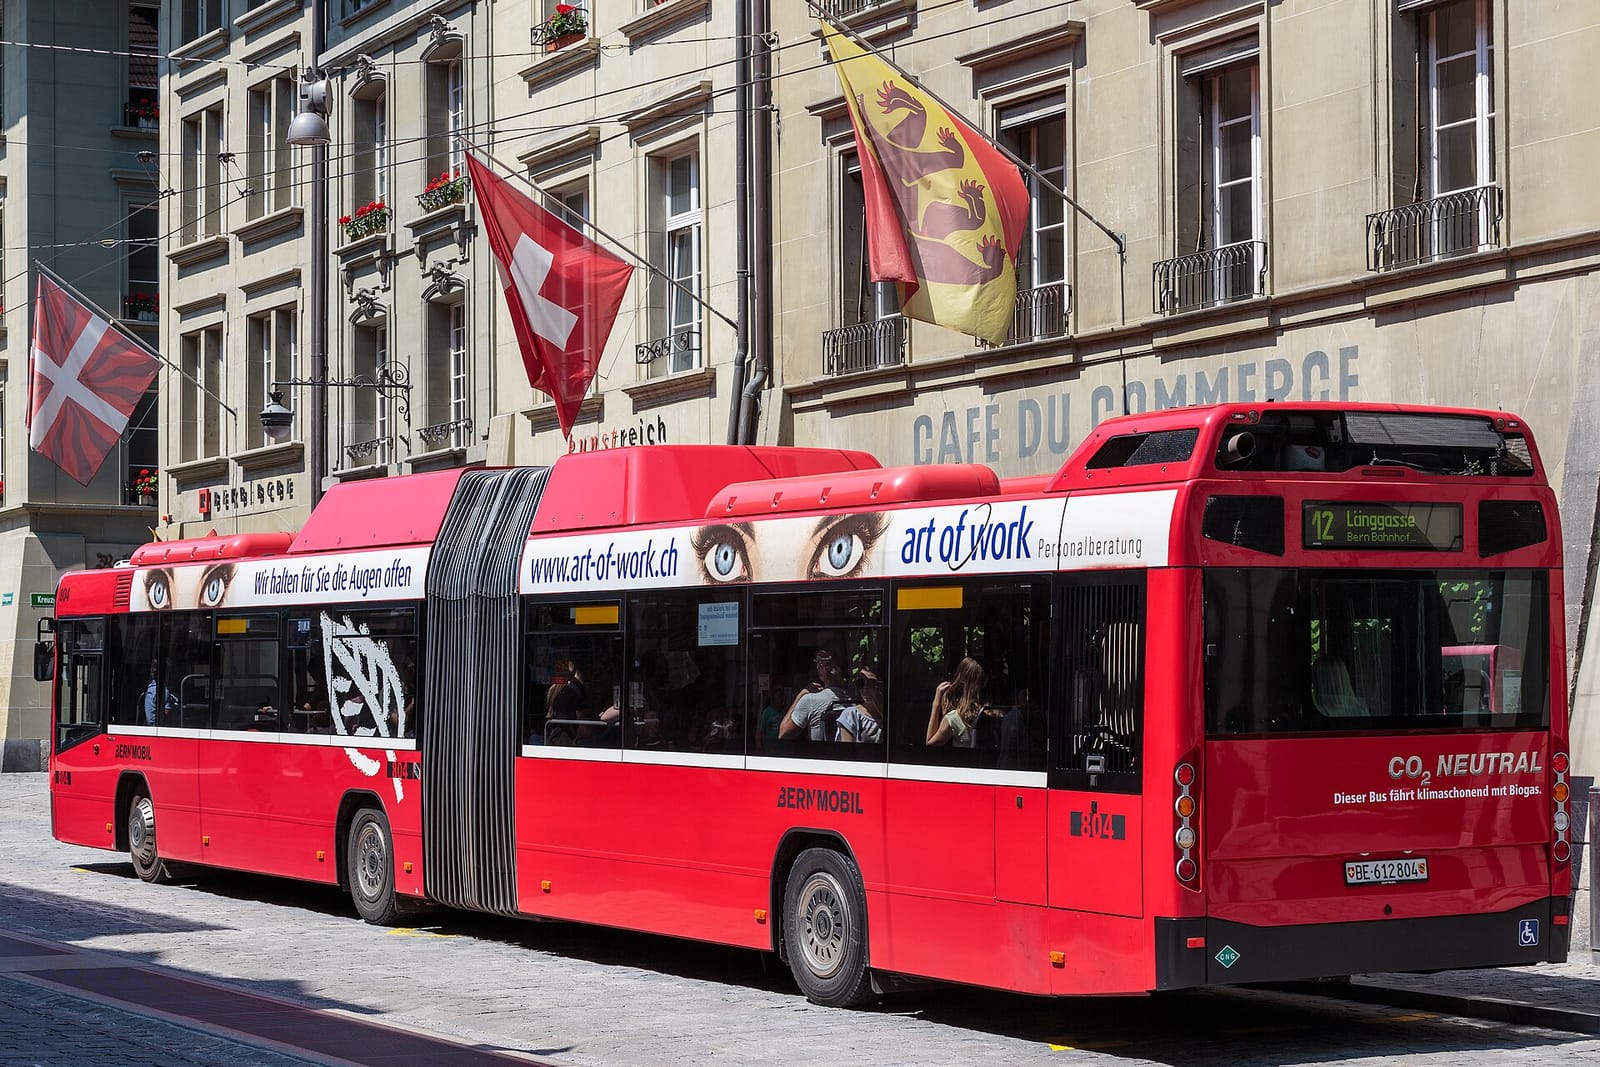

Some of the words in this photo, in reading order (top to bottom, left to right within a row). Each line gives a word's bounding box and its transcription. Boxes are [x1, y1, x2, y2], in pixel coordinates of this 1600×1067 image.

[913, 394, 1000, 465] CAFÉ
[1018, 393, 1071, 458] DU
[901, 517, 936, 564] art
[939, 508, 969, 562] of
[971, 505, 1034, 561] work
[1311, 510, 1335, 541] 12
[1346, 510, 1416, 531] Länggasse
[1347, 532, 1370, 542] Bern
[531, 537, 678, 584] www.art-of-work.ch
[1038, 535, 1142, 559] Personalberatung
[254, 568, 270, 595] Wir
[269, 566, 299, 594] halten
[300, 565, 315, 593] für
[316, 563, 330, 592] Sie
[332, 562, 348, 591] die
[350, 564, 382, 597] Augen
[384, 558, 412, 588] offen
[1436, 751, 1543, 777] NEUTRAL
[777, 786, 864, 815] BERNMOBIL
[1334, 791, 1367, 804] Dieser
[1369, 791, 1387, 803] Bus
[1389, 788, 1415, 802] fährt
[1417, 785, 1489, 800] klimaschonend
[1491, 785, 1507, 797] mit
[1509, 784, 1542, 798] Biogas.
[1081, 812, 1112, 839] 804
[1219, 953, 1236, 961] CNG
